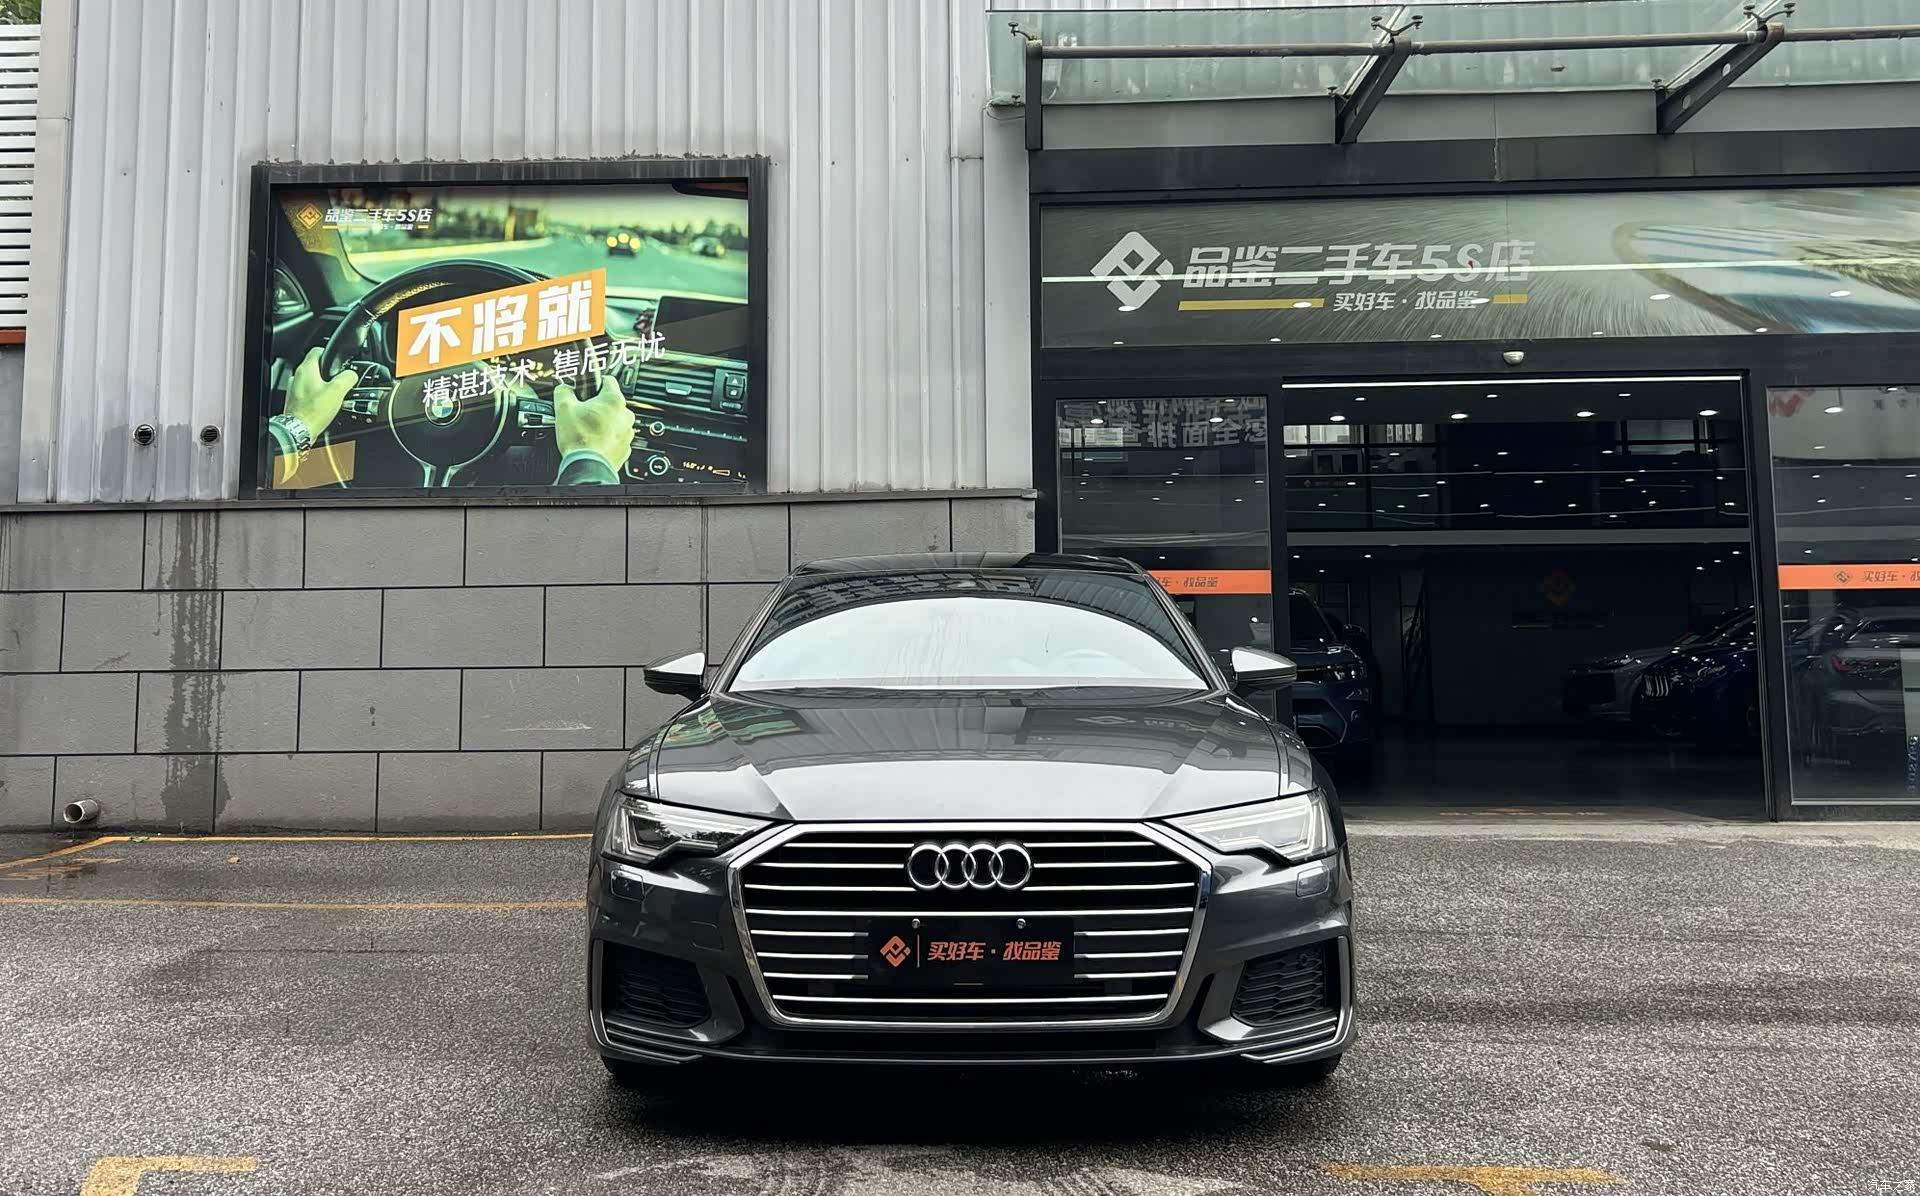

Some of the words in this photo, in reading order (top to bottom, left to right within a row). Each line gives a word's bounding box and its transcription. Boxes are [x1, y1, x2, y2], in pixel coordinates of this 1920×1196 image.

[324, 207, 433, 222] 品鉴二手车5S店
[1183, 240, 1535, 288] 品鉴二手车5S店
[407, 279, 592, 364] 不将就
[422, 358, 538, 403] 精湛技术
[552, 331, 667, 380] 售后无忧
